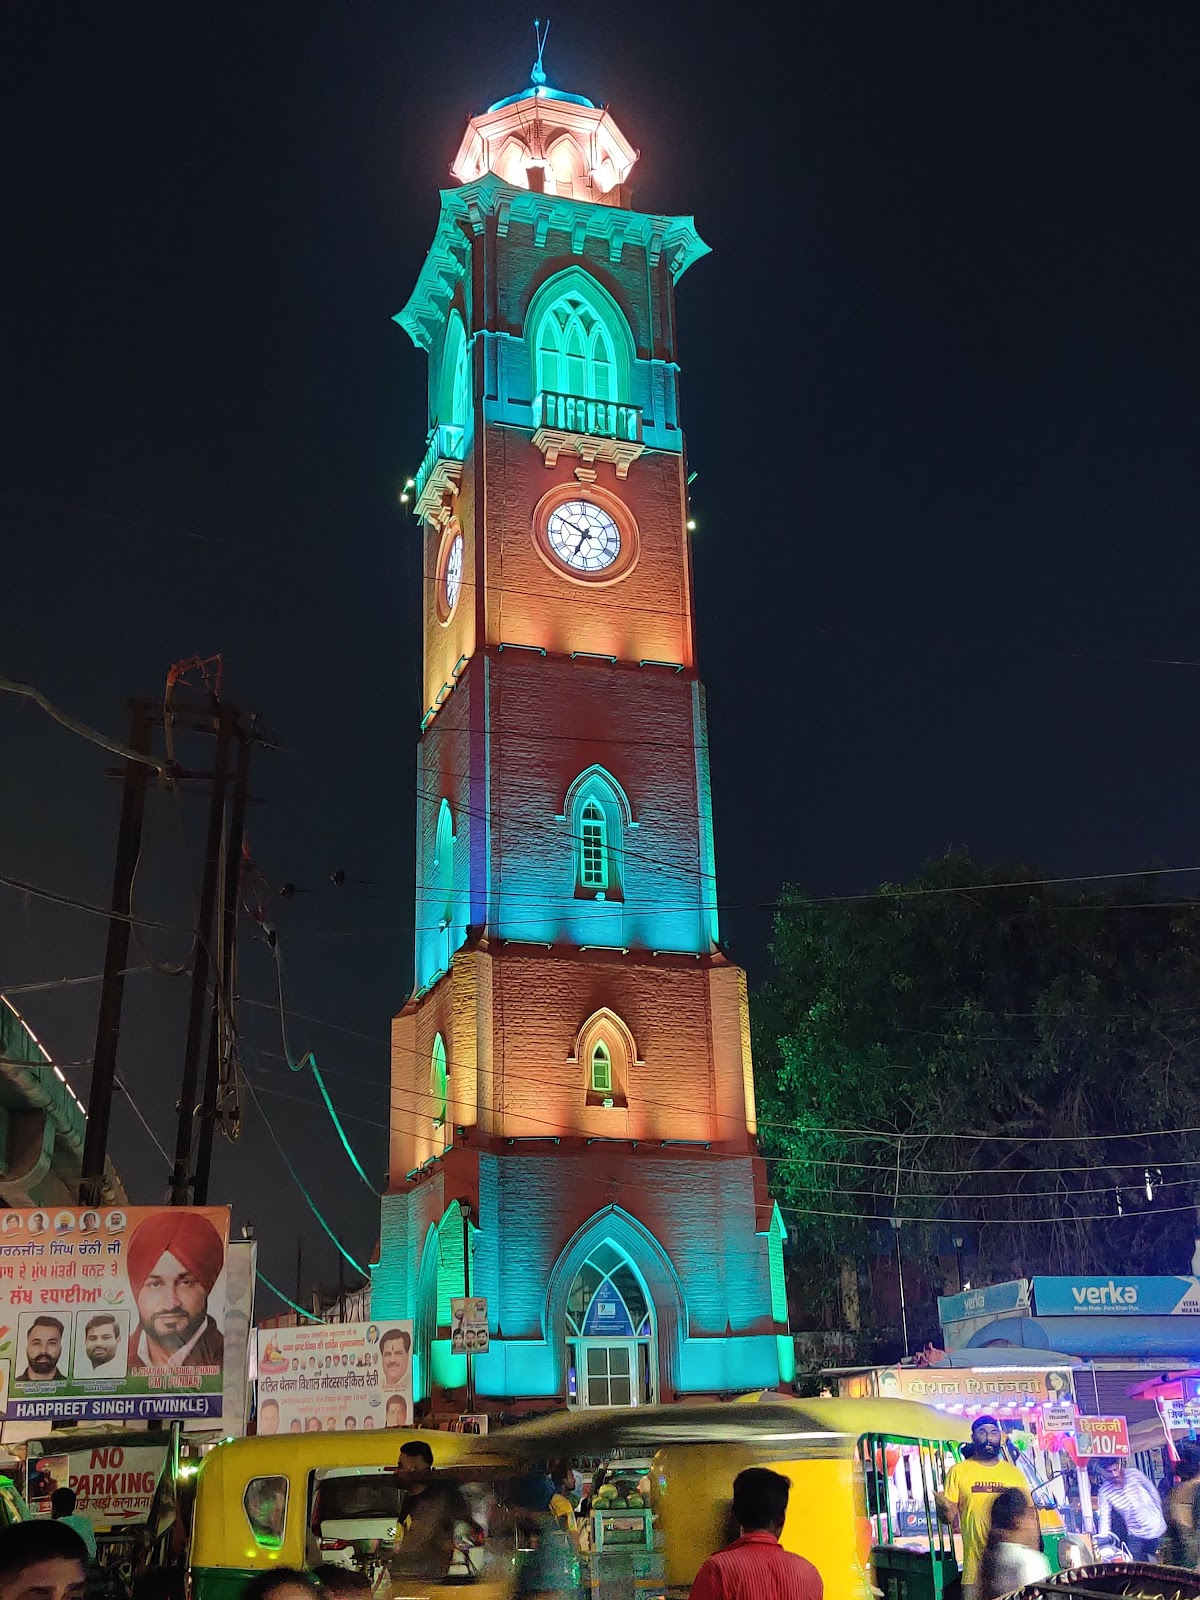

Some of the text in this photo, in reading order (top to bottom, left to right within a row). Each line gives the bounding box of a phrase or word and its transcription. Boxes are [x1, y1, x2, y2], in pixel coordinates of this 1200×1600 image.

[49, 1240, 74, 1255] ਸਿੰਘ
[78, 1239, 102, 1255] ਚੰਨੀ
[107, 1239, 121, 1254] ਜੀ
[19, 1262, 26, 1280] ਦੇ
[50, 1261, 77, 1278] ਮੰਤਰੀ
[111, 1260, 118, 1277] ਤੇ
[10, 1284, 102, 1304] ਲੱਖ ਵਧਾਈਆਂ
[1072, 1280, 1137, 1304] verka
[260, 1377, 278, 1392] दलित
[279, 1376, 297, 1391] चेतना
[299, 1374, 320, 1391] विशाल
[366, 1369, 378, 1387] रैली
[964, 1377, 1042, 1394] शिकंजवी
[16, 1398, 209, 1417] HARPREET SINGH (TWINKLE)
[1080, 1418, 1122, 1433] शिकंजी
[89, 1447, 124, 1470] NO
[76, 1495, 91, 1511] ाड़ी
[112, 1497, 133, 1509] करना
